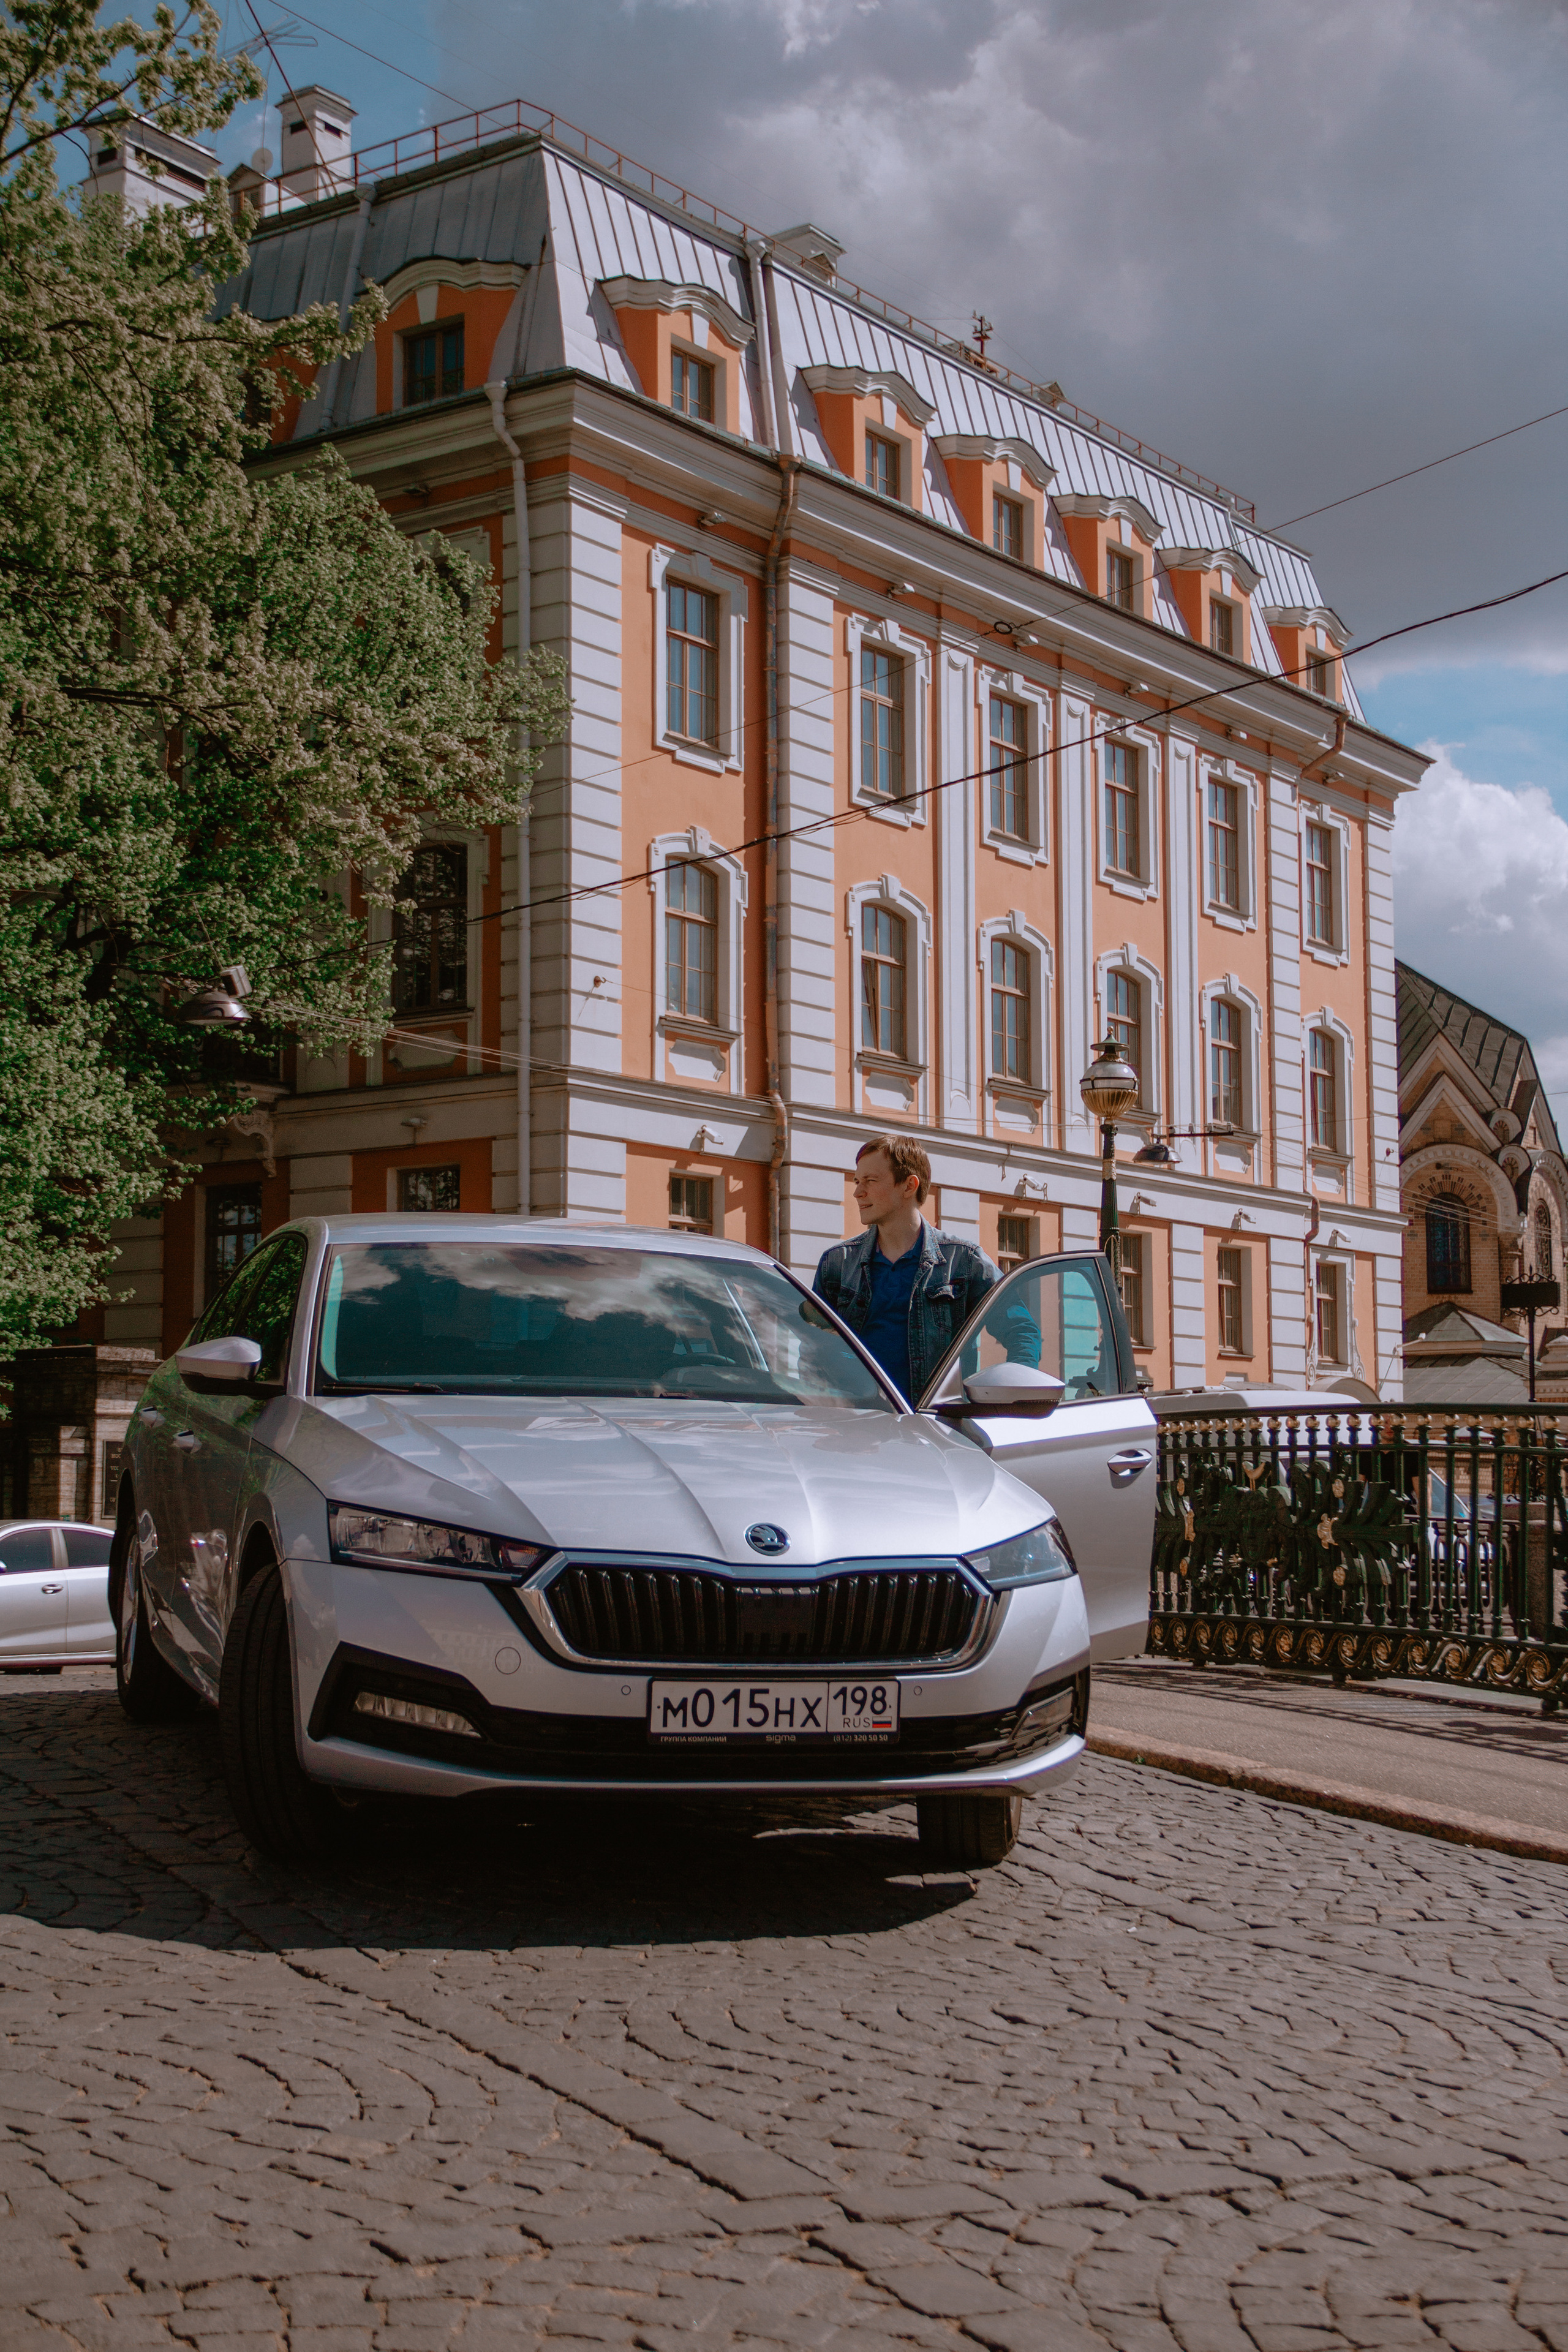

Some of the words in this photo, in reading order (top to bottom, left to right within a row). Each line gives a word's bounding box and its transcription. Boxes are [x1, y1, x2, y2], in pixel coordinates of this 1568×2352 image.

[832, 1685, 888, 1716] 198
[842, 1717, 871, 1728] RUS
[766, 1733, 796, 1744] sigma
[833, 1734, 852, 1743] (812)
